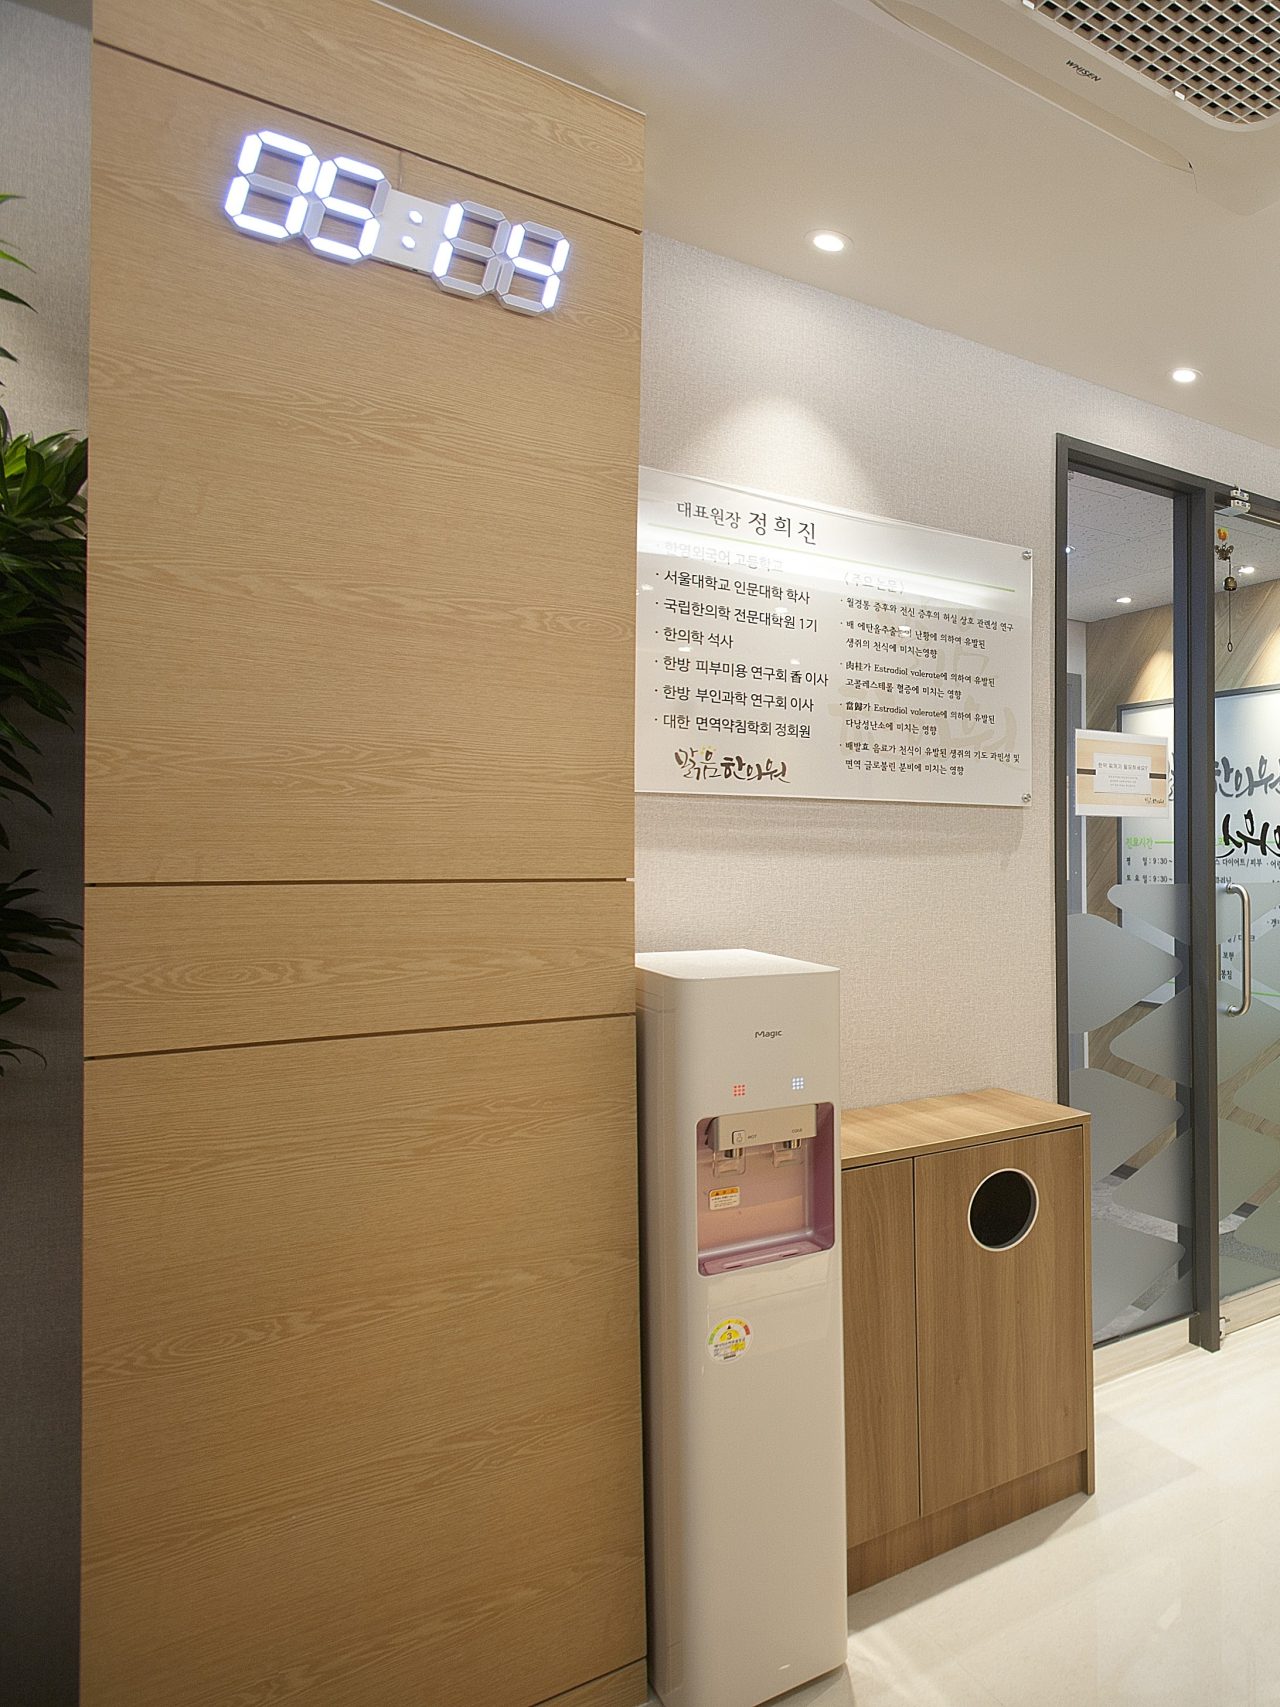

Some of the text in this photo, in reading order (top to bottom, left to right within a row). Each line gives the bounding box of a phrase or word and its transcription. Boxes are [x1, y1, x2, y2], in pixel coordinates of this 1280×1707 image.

[223, 130, 571, 312] 05:14
[677, 502, 741, 529] 대표원장
[664, 570, 810, 605] 서울대학교 인문대학 학사
[664, 598, 818, 632] 국립한의학 전문대학원 1기
[846, 598, 1014, 632] 월경통 증후와 전신 증후의 허실 상호 관련성 연구
[663, 627, 734, 649] 한의학 석사
[846, 638, 870, 649] 생쥐의
[873, 641, 897, 653] 천식에
[940, 634, 962, 645] 의하여
[964, 637, 986, 650] 유발된
[663, 656, 691, 672] 한방
[696, 660, 748, 679] 피부미용
[751, 666, 787, 683] 연구회
[805, 672, 829, 687] 이사
[874, 664, 908, 676] Estradiol
[910, 670, 947, 681] valerate에
[950, 673, 972, 683] 의하여
[974, 676, 995, 687] 유발된
[663, 685, 814, 712] 한방 부인과학 연구회 이사
[846, 678, 962, 700] 고콜레스테롤 혈증에 미치는 영향
[874, 704, 908, 715] Estradiol
[910, 708, 947, 719] valerate에
[950, 711, 972, 721] 의하여
[974, 713, 995, 724] 유발된
[663, 714, 811, 738] 대한 면역약침학회 정회원
[846, 719, 937, 736] 다낭성난소에 미치는 영향
[873, 743, 896, 754] 음료가
[899, 745, 922, 757] 천식이
[925, 746, 947, 758] 유발된
[950, 748, 971, 759] 생쥐의
[973, 750, 988, 760] 기도
[990, 752, 1010, 763] 과민성
[1013, 754, 1020, 763] 및
[845, 759, 860, 771] 면역
[898, 763, 922, 773] 분비에
[925, 764, 947, 775] 미치는
[950, 765, 964, 776] 영향
